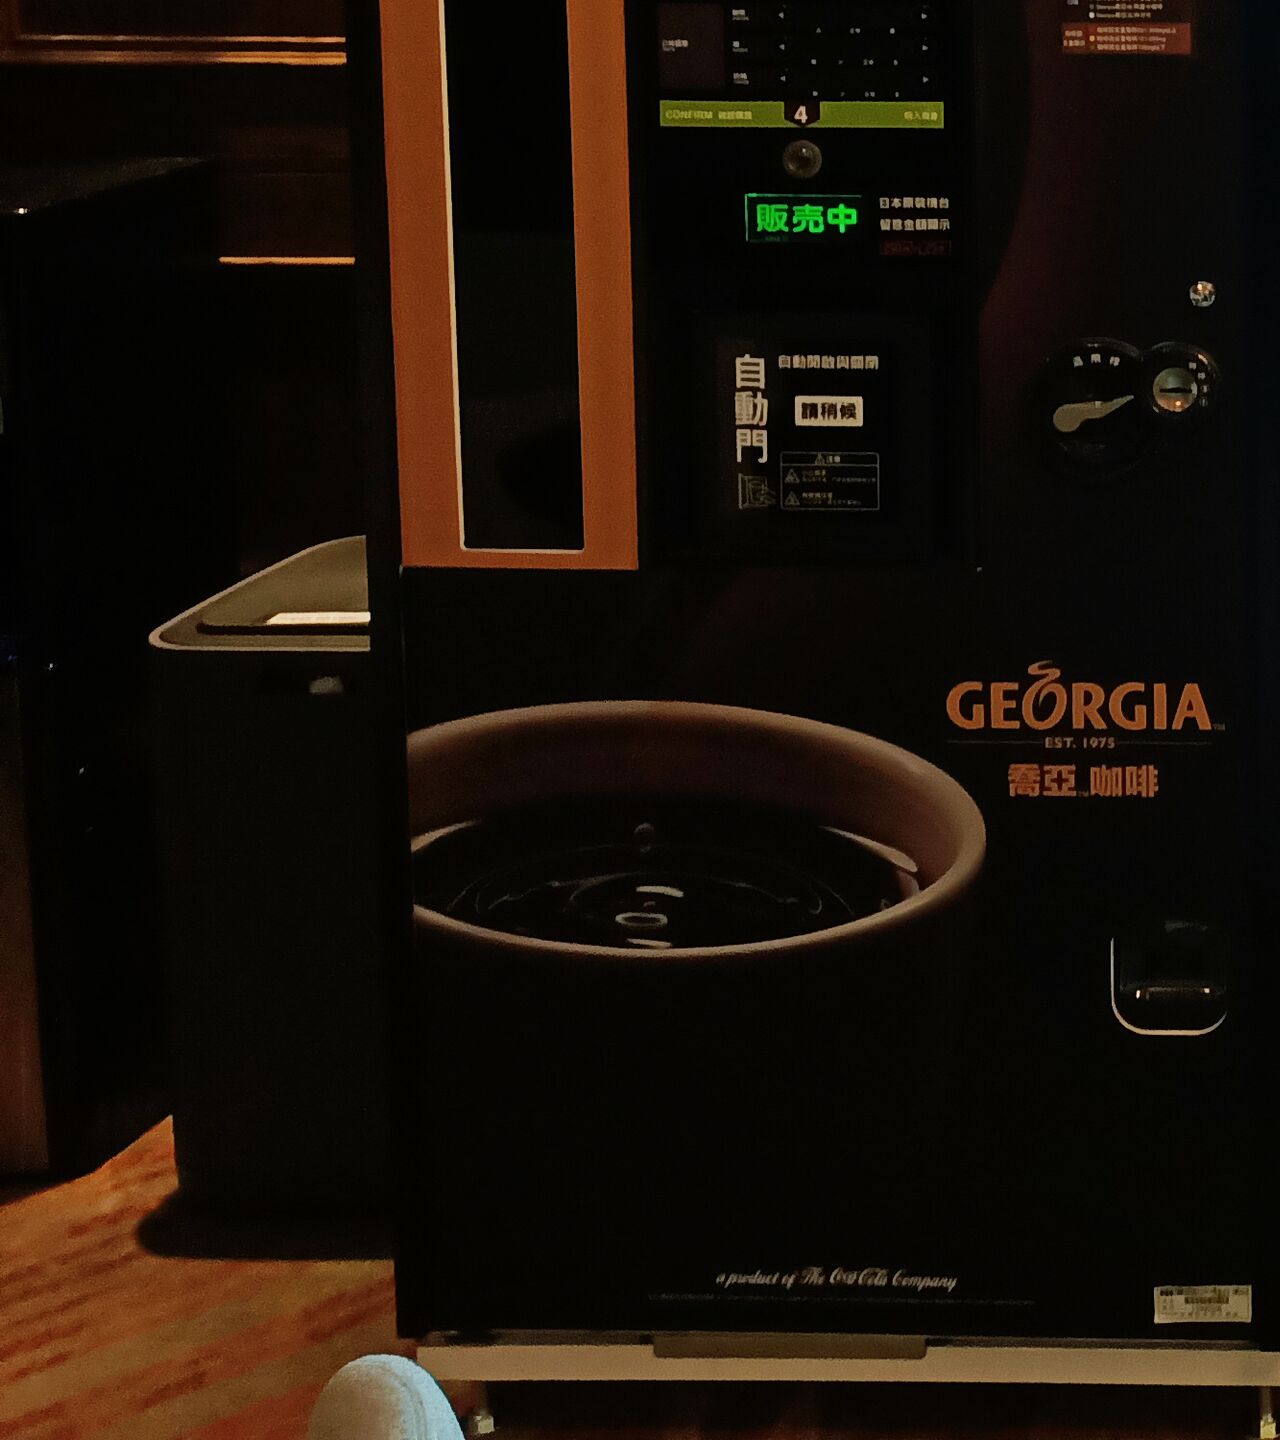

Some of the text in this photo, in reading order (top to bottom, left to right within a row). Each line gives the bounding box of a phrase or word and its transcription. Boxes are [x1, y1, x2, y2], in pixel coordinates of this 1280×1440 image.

[794, 105, 808, 124] 4
[756, 203, 858, 234] 販売中
[734, 353, 768, 464] 自動門
[801, 401, 858, 421] 請稍候
[946, 660, 1212, 730] GEORGIA
[1044, 736, 1116, 749] EST. 1975
[725, 1269, 777, 1289] product
[781, 1272, 798, 1290] of
[800, 1266, 825, 1285] The
[892, 1269, 958, 1292] Company
